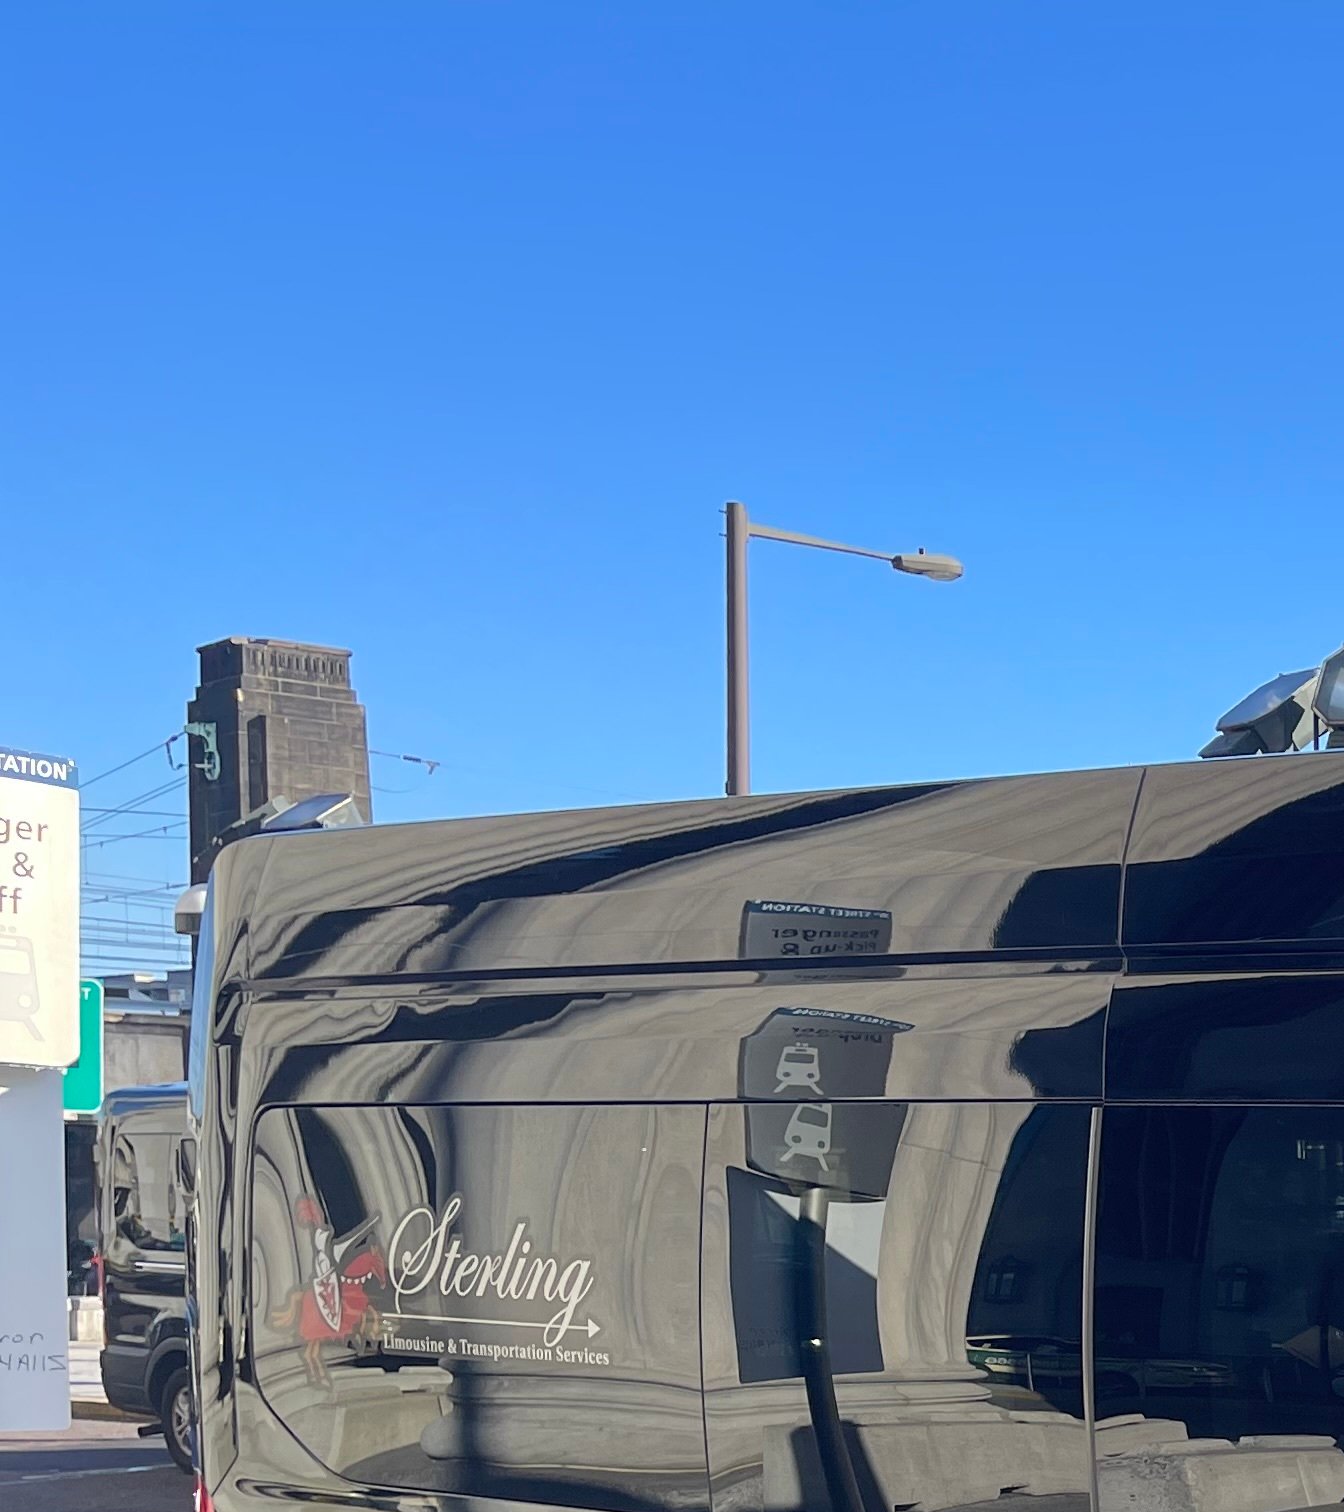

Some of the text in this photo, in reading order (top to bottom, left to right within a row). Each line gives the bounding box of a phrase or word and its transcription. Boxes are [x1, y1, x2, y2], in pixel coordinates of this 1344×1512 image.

[12, 851, 34, 879] &
[388, 1197, 594, 1348] Sterling
[383, 1333, 610, 1366] Limousine & Transportation Services
